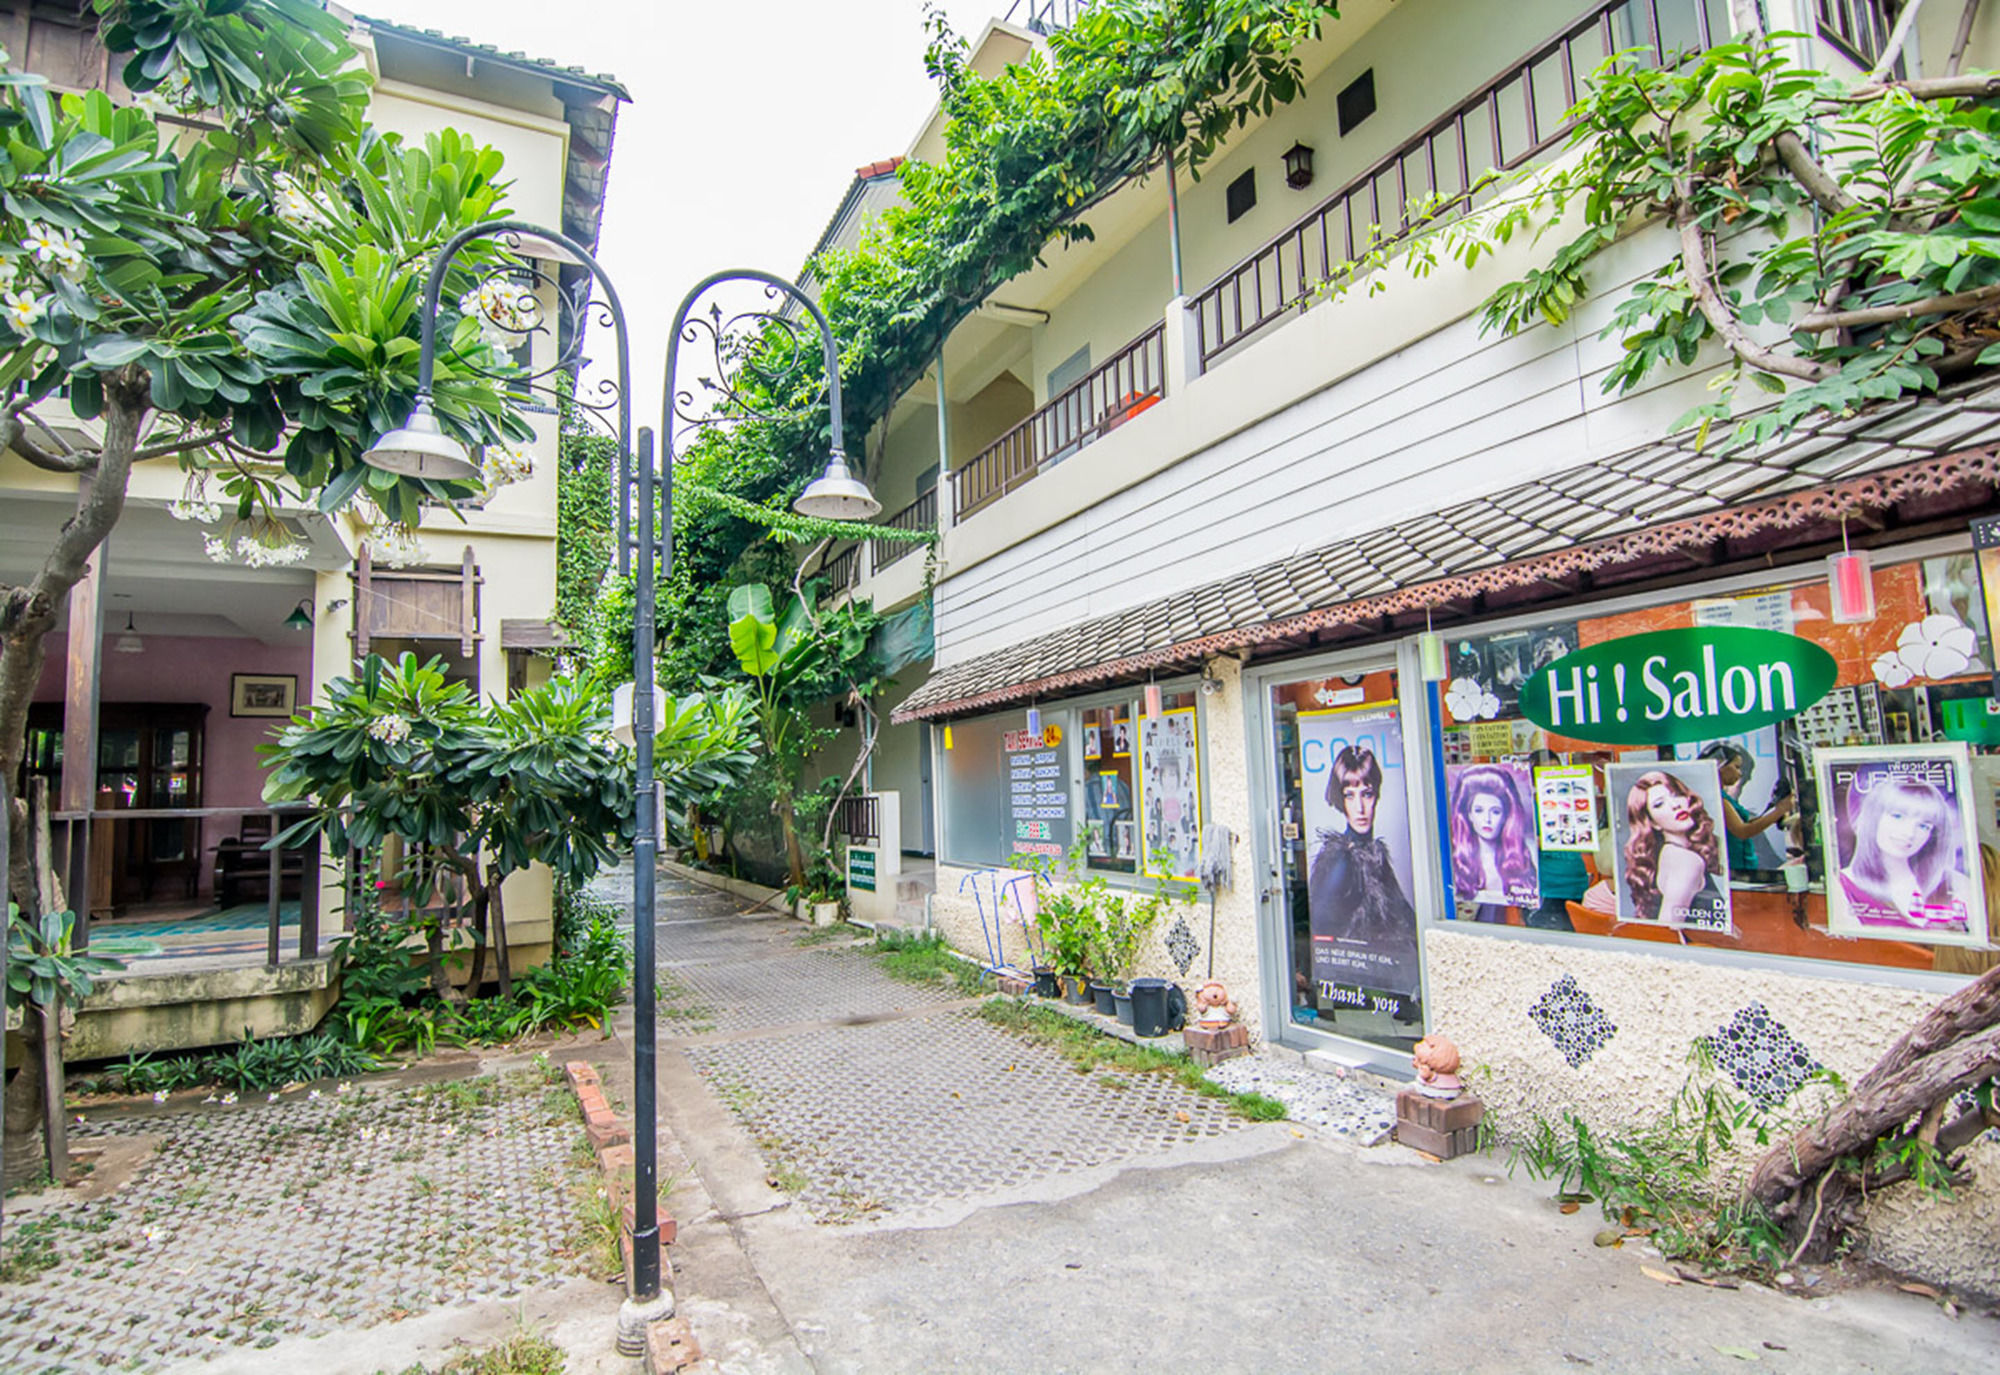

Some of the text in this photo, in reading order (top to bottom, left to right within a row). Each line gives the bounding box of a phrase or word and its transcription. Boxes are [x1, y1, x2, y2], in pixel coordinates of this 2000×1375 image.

[1547, 664, 1600, 727] Hi
[1643, 644, 1797, 722] Salon
[1673, 907, 1711, 918] GOLDEN
[1319, 979, 1401, 1016] Thank you
